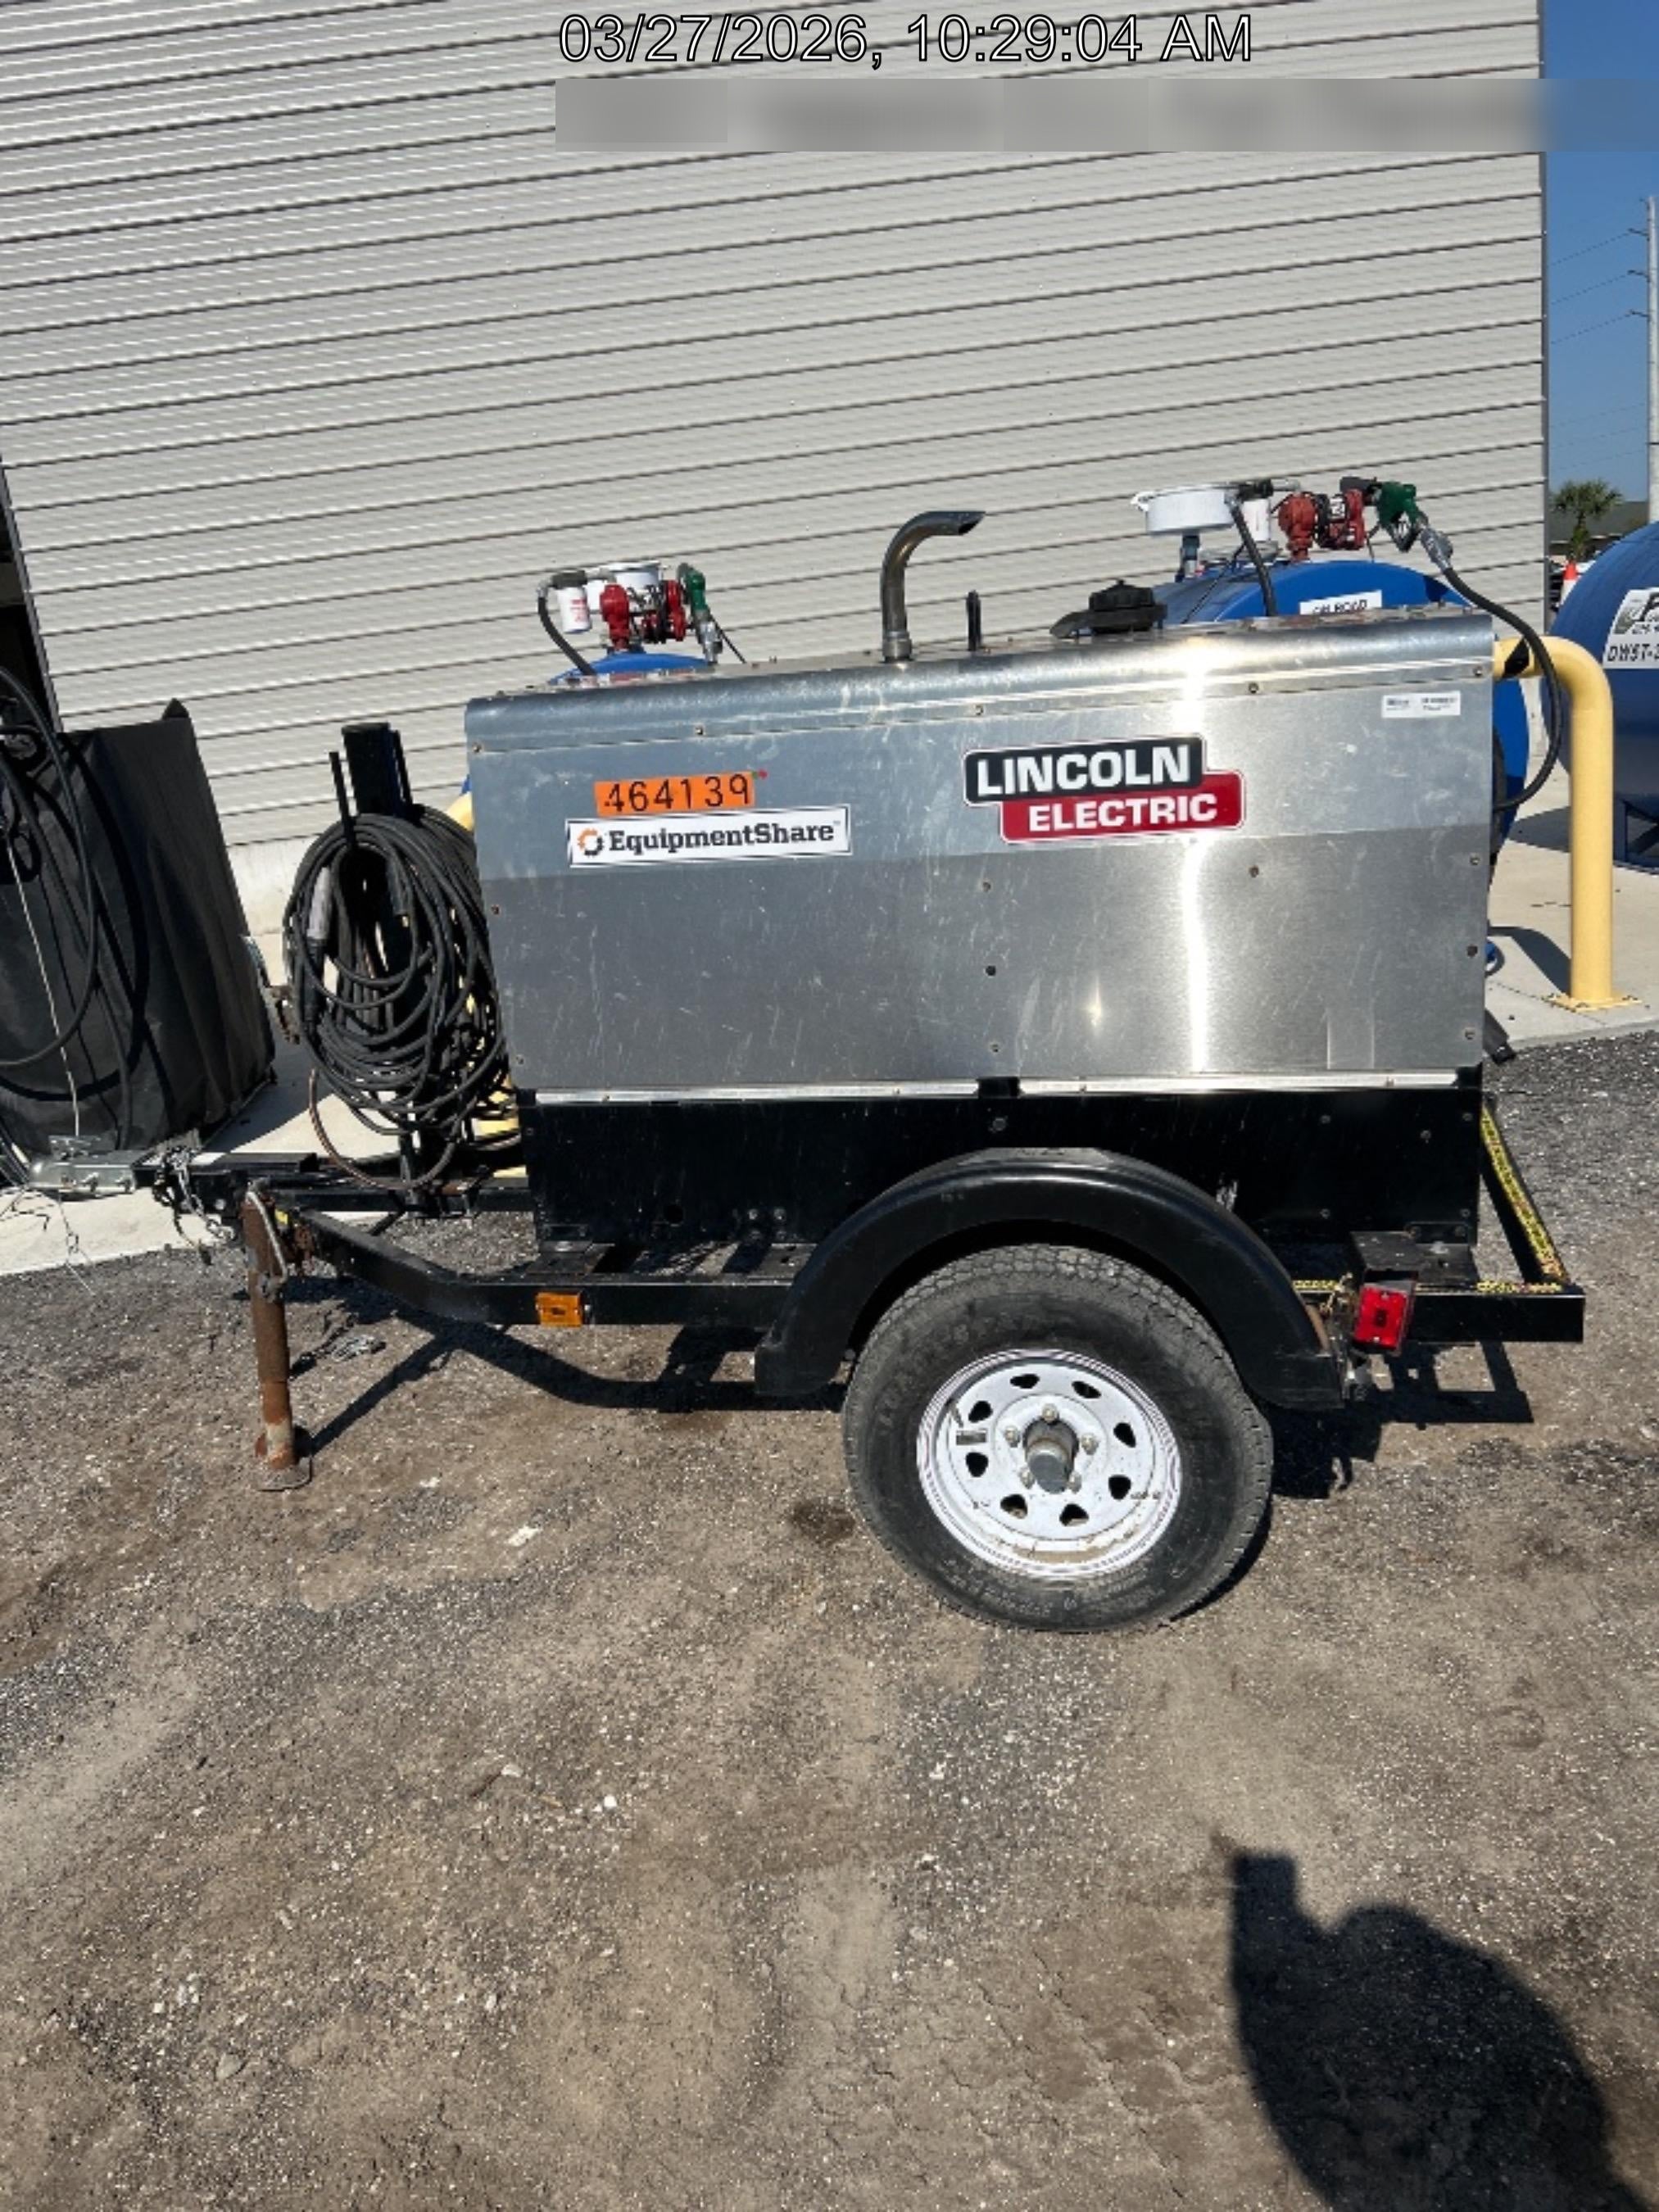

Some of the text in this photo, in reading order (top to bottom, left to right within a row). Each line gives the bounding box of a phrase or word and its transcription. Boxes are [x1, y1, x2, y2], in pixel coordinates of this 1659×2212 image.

[977, 744, 1190, 798] LINCOLN
[604, 773, 750, 812] 464139
[1028, 792, 1218, 832] ELECTRIC
[609, 823, 834, 855] EquipmentShare
